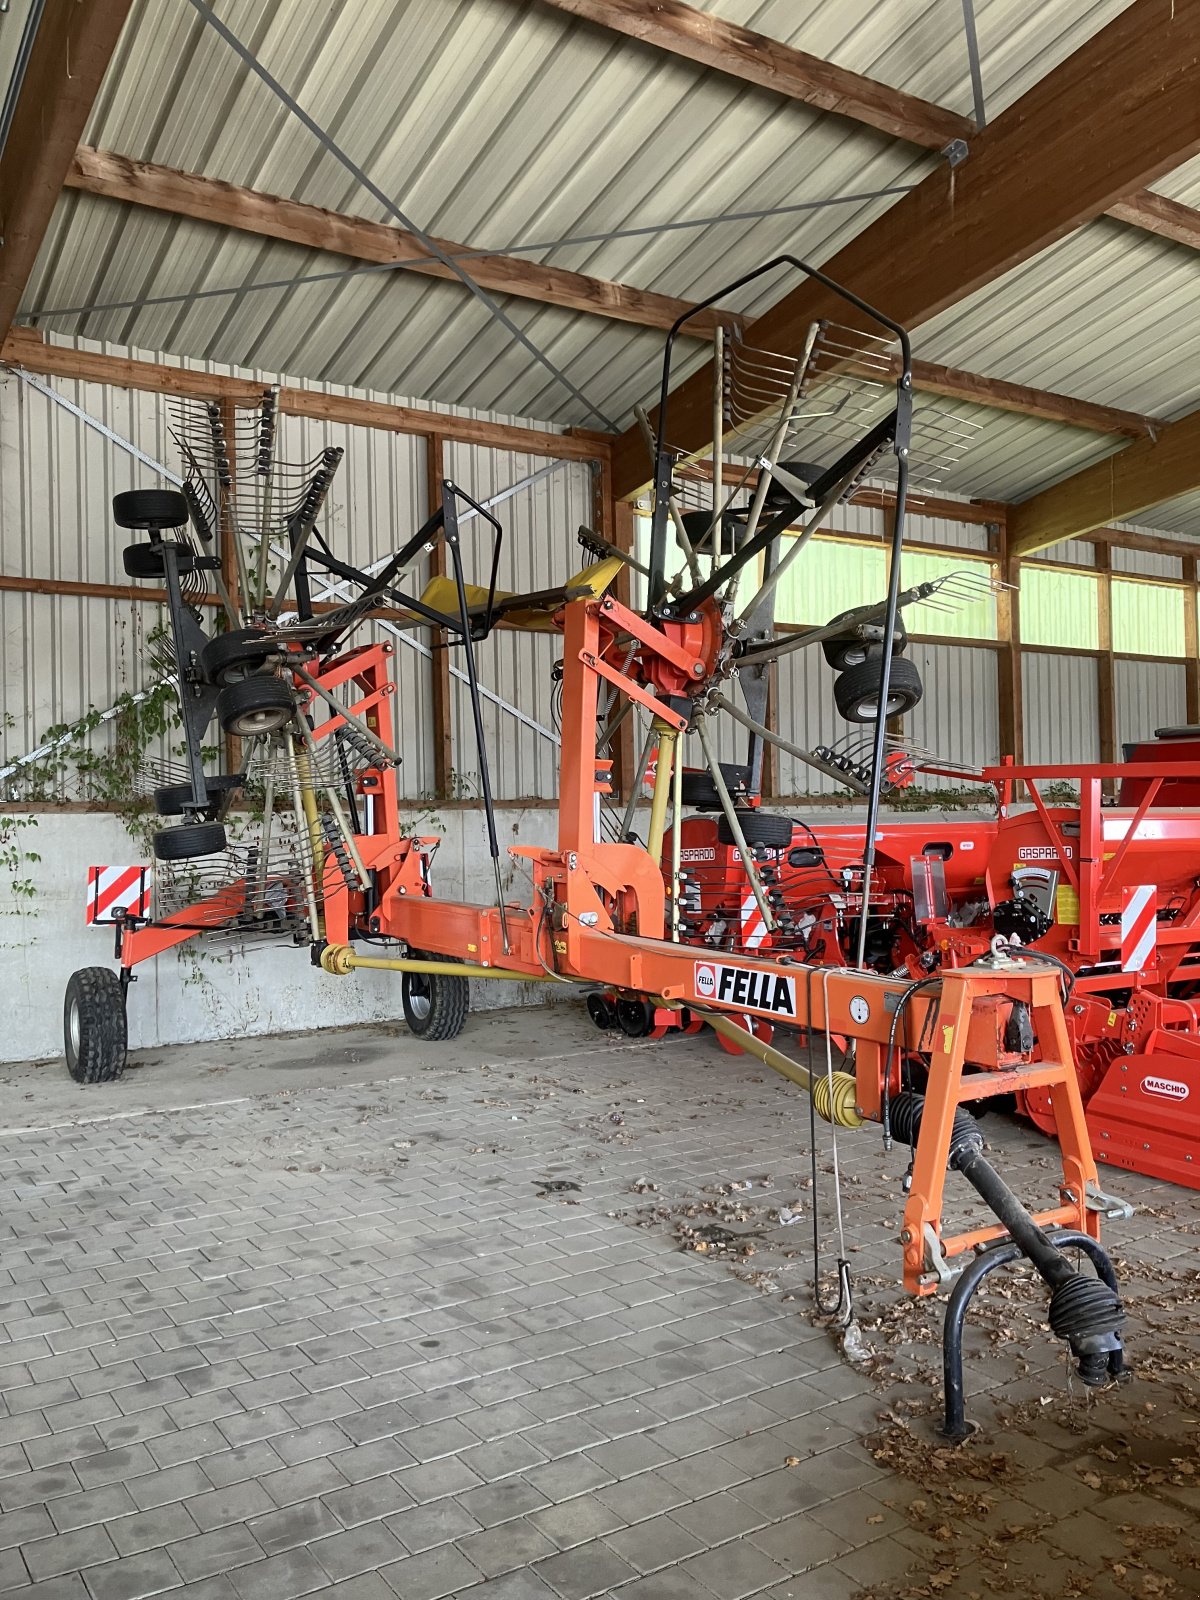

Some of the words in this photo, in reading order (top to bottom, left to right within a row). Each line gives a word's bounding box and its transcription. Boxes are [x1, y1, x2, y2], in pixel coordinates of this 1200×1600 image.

[680, 848, 715, 860] ASPARDO
[1019, 847, 1072, 859] GASPARO
[698, 975, 714, 986] FELLA
[717, 967, 794, 1015] FELLA
[1147, 1080, 1186, 1094] MASCHIO
